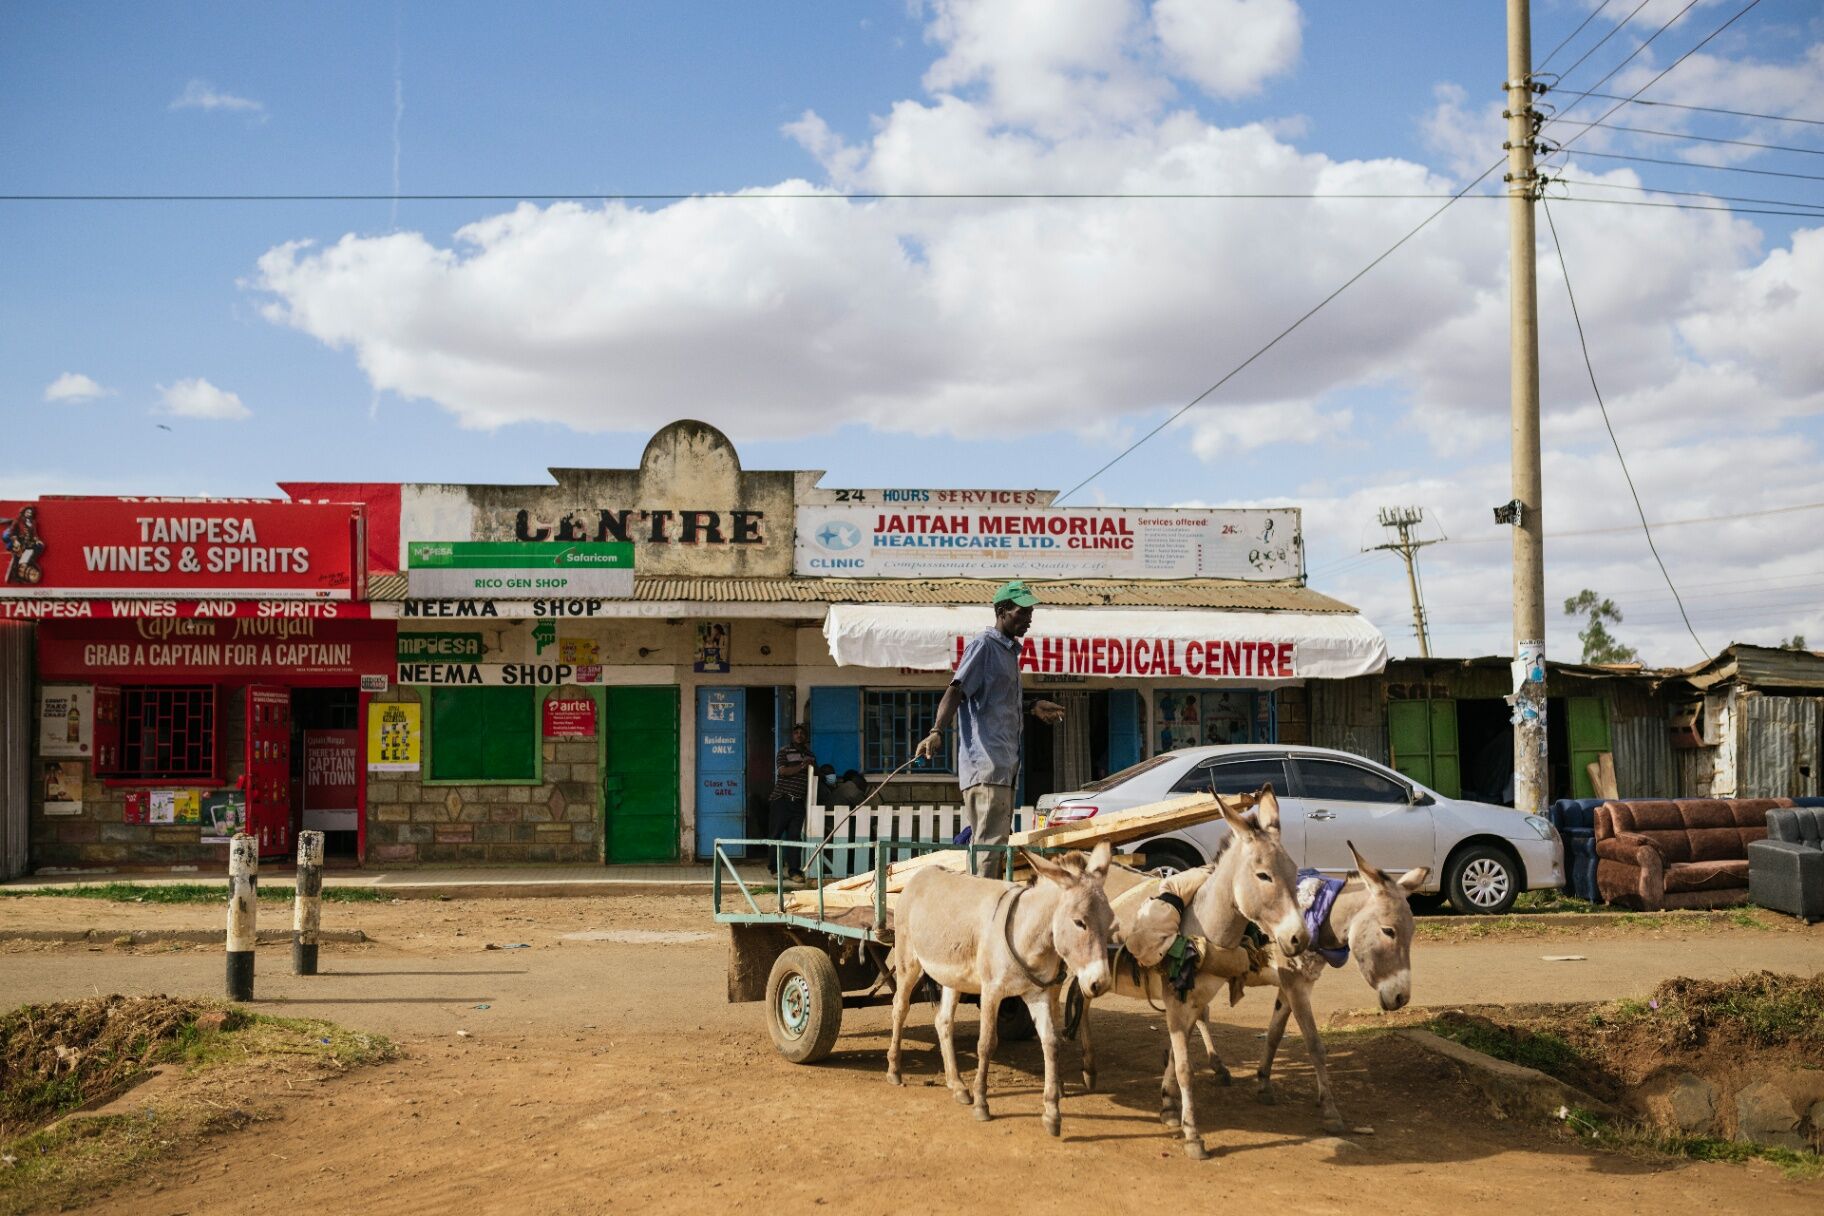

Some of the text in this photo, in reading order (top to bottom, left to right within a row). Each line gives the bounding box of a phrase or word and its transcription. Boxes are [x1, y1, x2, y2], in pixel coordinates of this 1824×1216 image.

[835, 490, 1037, 504] 24 HOURS SERVICES
[515, 508, 765, 544] CENTRE
[873, 514, 1134, 536] JAITAH MEMORIAL
[1137, 517, 1173, 526] Services
[136, 517, 257, 544] TANPESA
[873, 535, 1134, 550] HEALTHCARE LTD. CLINIC
[83, 546, 309, 574] WINES & SPIRITS
[566, 553, 618, 563] Safaricom
[809, 558, 865, 568] CLINIC
[883, 560, 978, 569] Compassionate
[981, 560, 1009, 568] Care
[1030, 561, 1077, 570] Quality
[474, 579, 568, 588] RICO GEN SHOP
[1, 601, 338, 619] TANPESA WINES AND SPIRITS
[404, 599, 499, 617] NEEMA
[533, 599, 602, 616] SHOP
[84, 644, 352, 666] GRAB A CAPTAIN FOR A CAPTAIN!
[1069, 638, 1182, 675] MEDICAL
[1186, 641, 1295, 677] CENTRE
[400, 664, 484, 684] NEEMA
[502, 664, 573, 685] SHOP
[559, 700, 591, 711] airtel
[308, 757, 356, 771] CAPTAIN
[308, 772, 356, 786] IN TOWN
